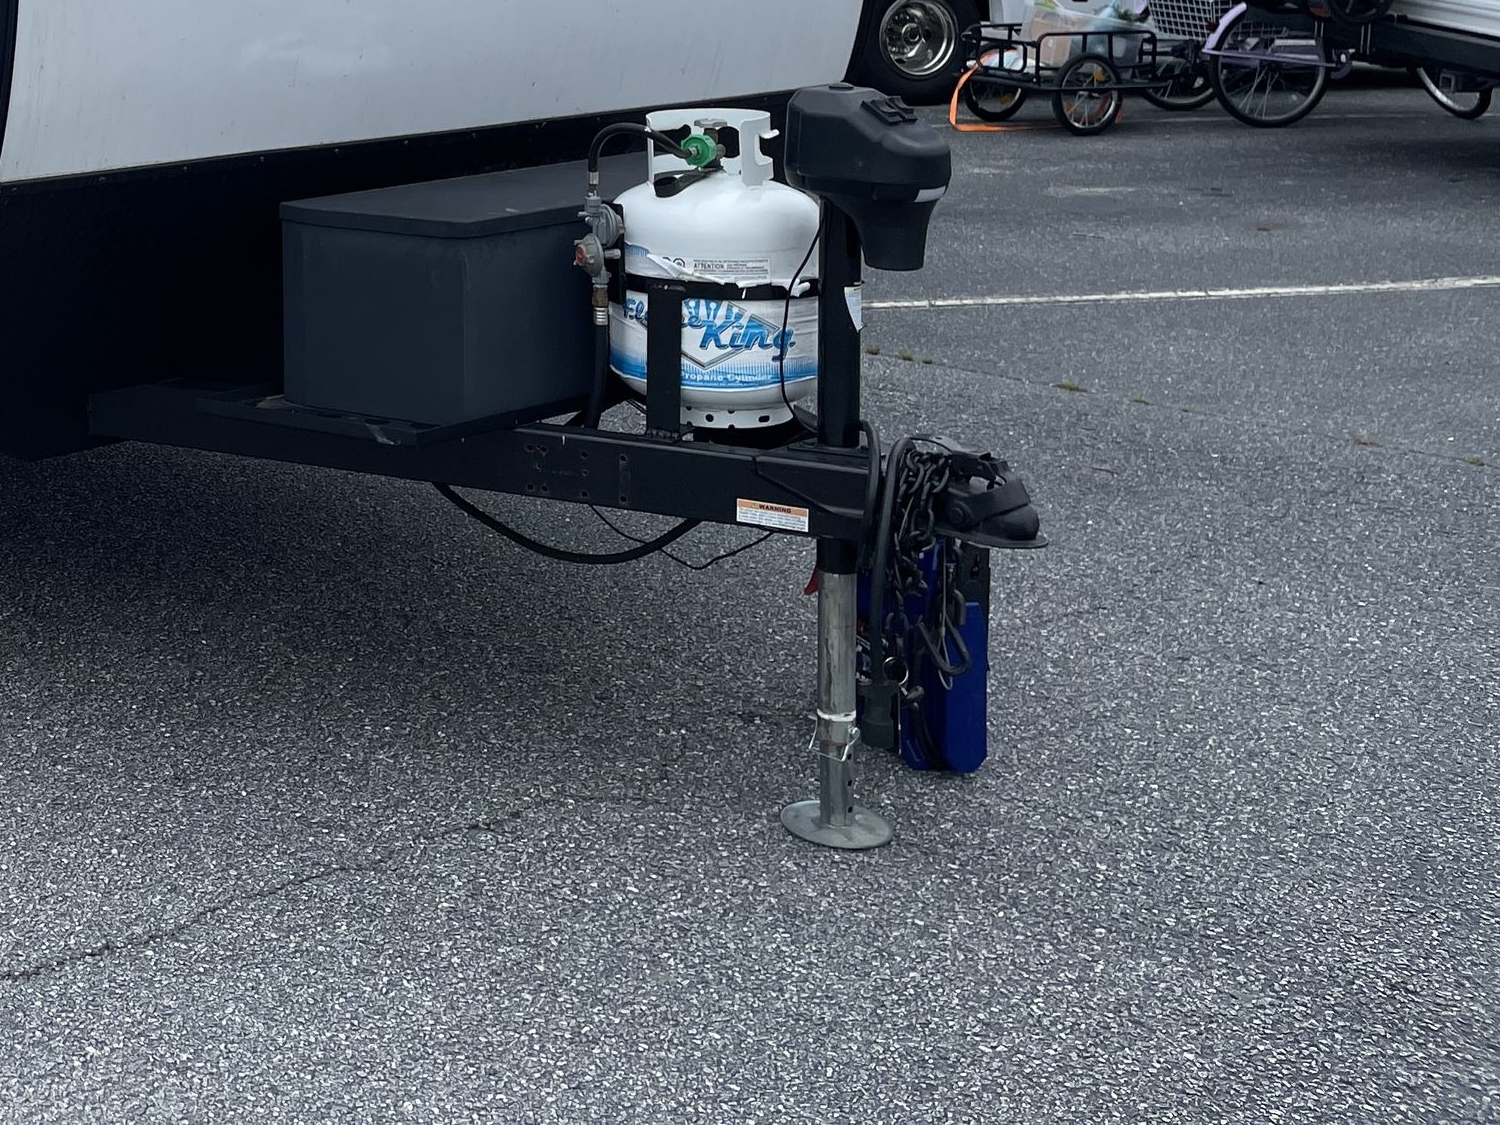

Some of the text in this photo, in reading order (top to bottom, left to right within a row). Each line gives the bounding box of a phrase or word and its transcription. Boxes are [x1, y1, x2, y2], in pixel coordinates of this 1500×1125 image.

[622, 298, 704, 329] Fle
[700, 318, 796, 362] King
[759, 504, 792, 513] WARNING
